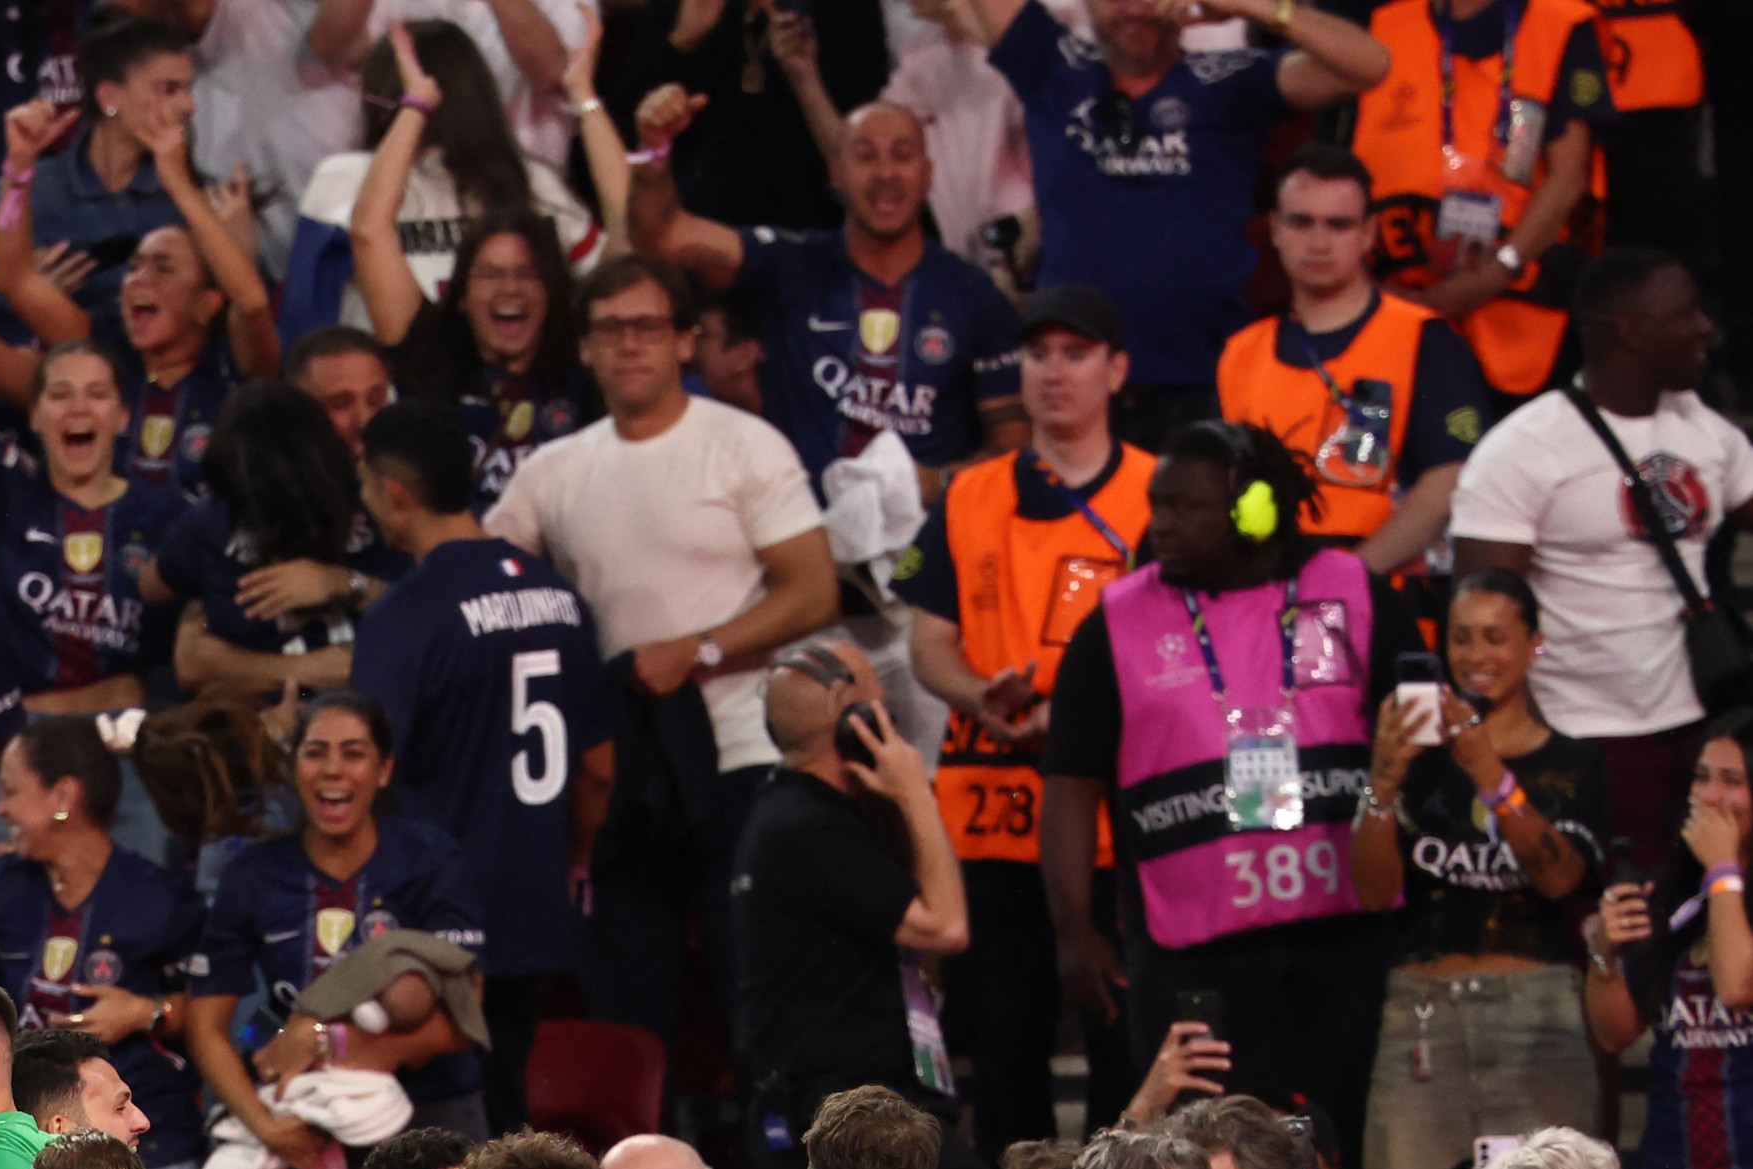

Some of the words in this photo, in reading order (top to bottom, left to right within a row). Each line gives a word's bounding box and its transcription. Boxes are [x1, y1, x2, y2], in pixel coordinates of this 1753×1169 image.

[812, 355, 938, 418] QATAR
[17, 569, 144, 633] QATAR
[518, 648, 569, 806] 5
[1226, 850, 1340, 909] 389
[1411, 835, 1520, 879] QATA
